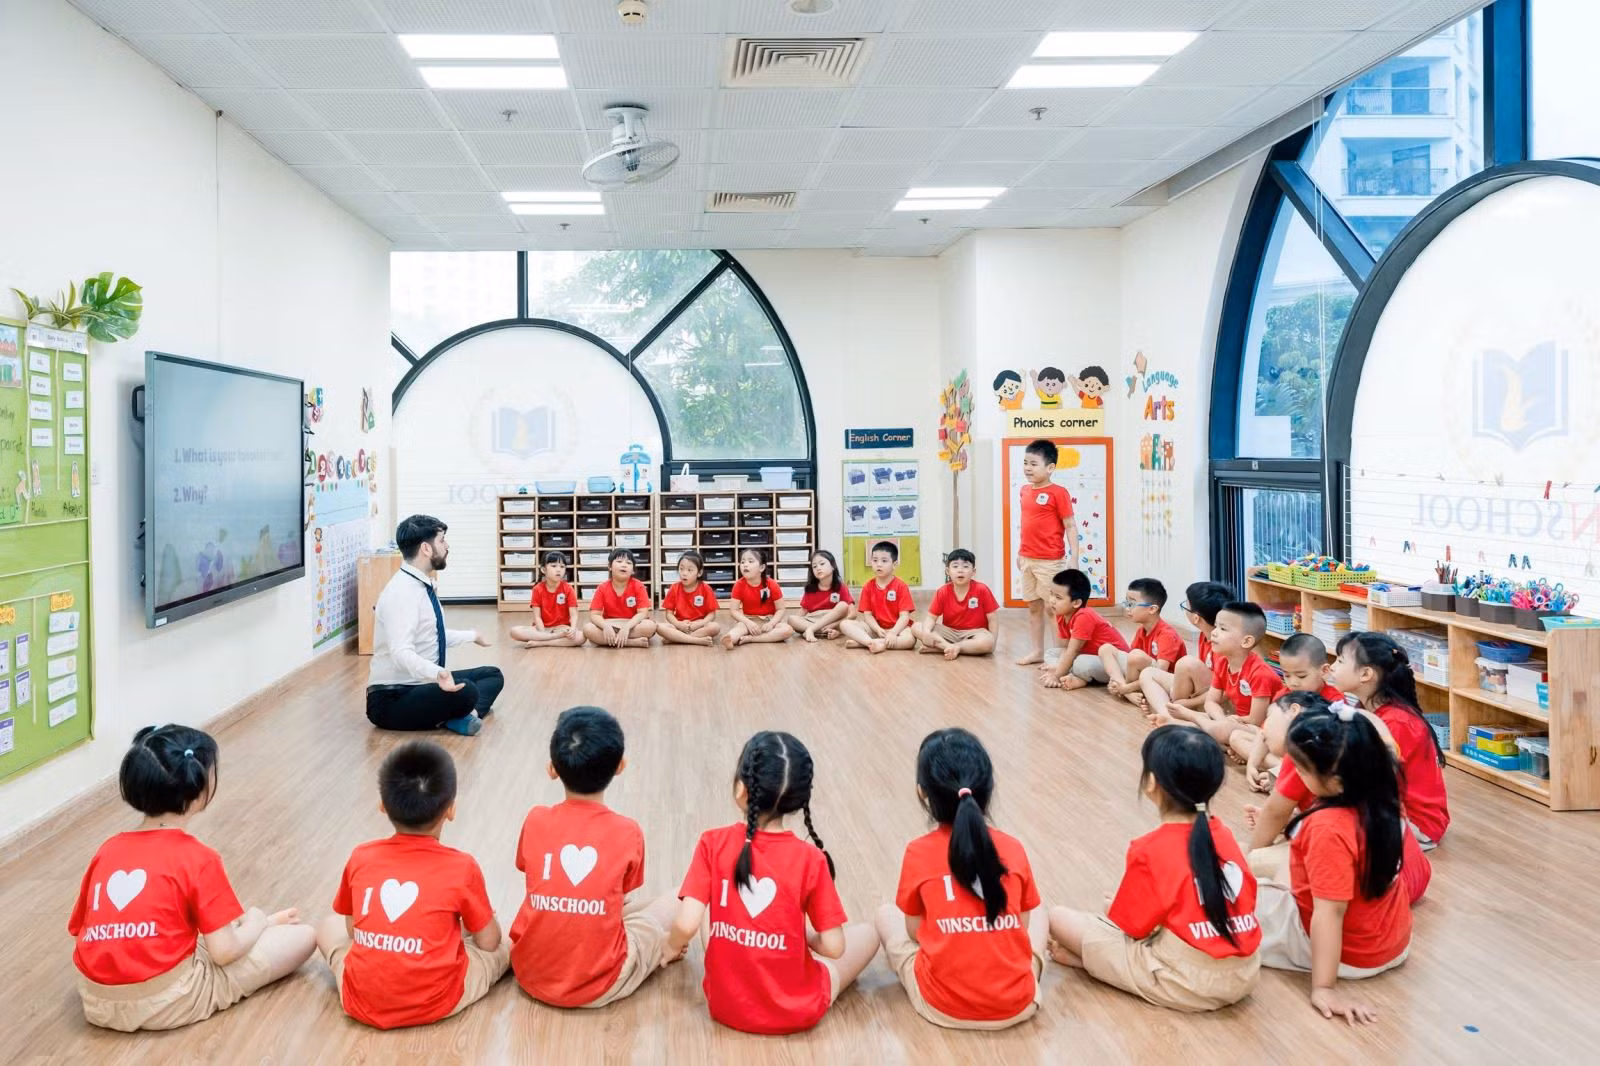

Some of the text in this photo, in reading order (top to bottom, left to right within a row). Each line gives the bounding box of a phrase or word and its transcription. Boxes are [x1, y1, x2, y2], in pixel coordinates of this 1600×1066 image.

[1142, 370, 1179, 393] Language
[1144, 395, 1175, 421] Arts
[1013, 417, 1099, 428] Phonics corner
[849, 433, 911, 444] English Corner
[542, 852, 552, 881] I
[93, 882, 102, 912] I
[361, 887, 374, 916] I
[719, 879, 729, 908] I
[943, 874, 955, 902] I
[530, 893, 607, 916] VINSCHOOL
